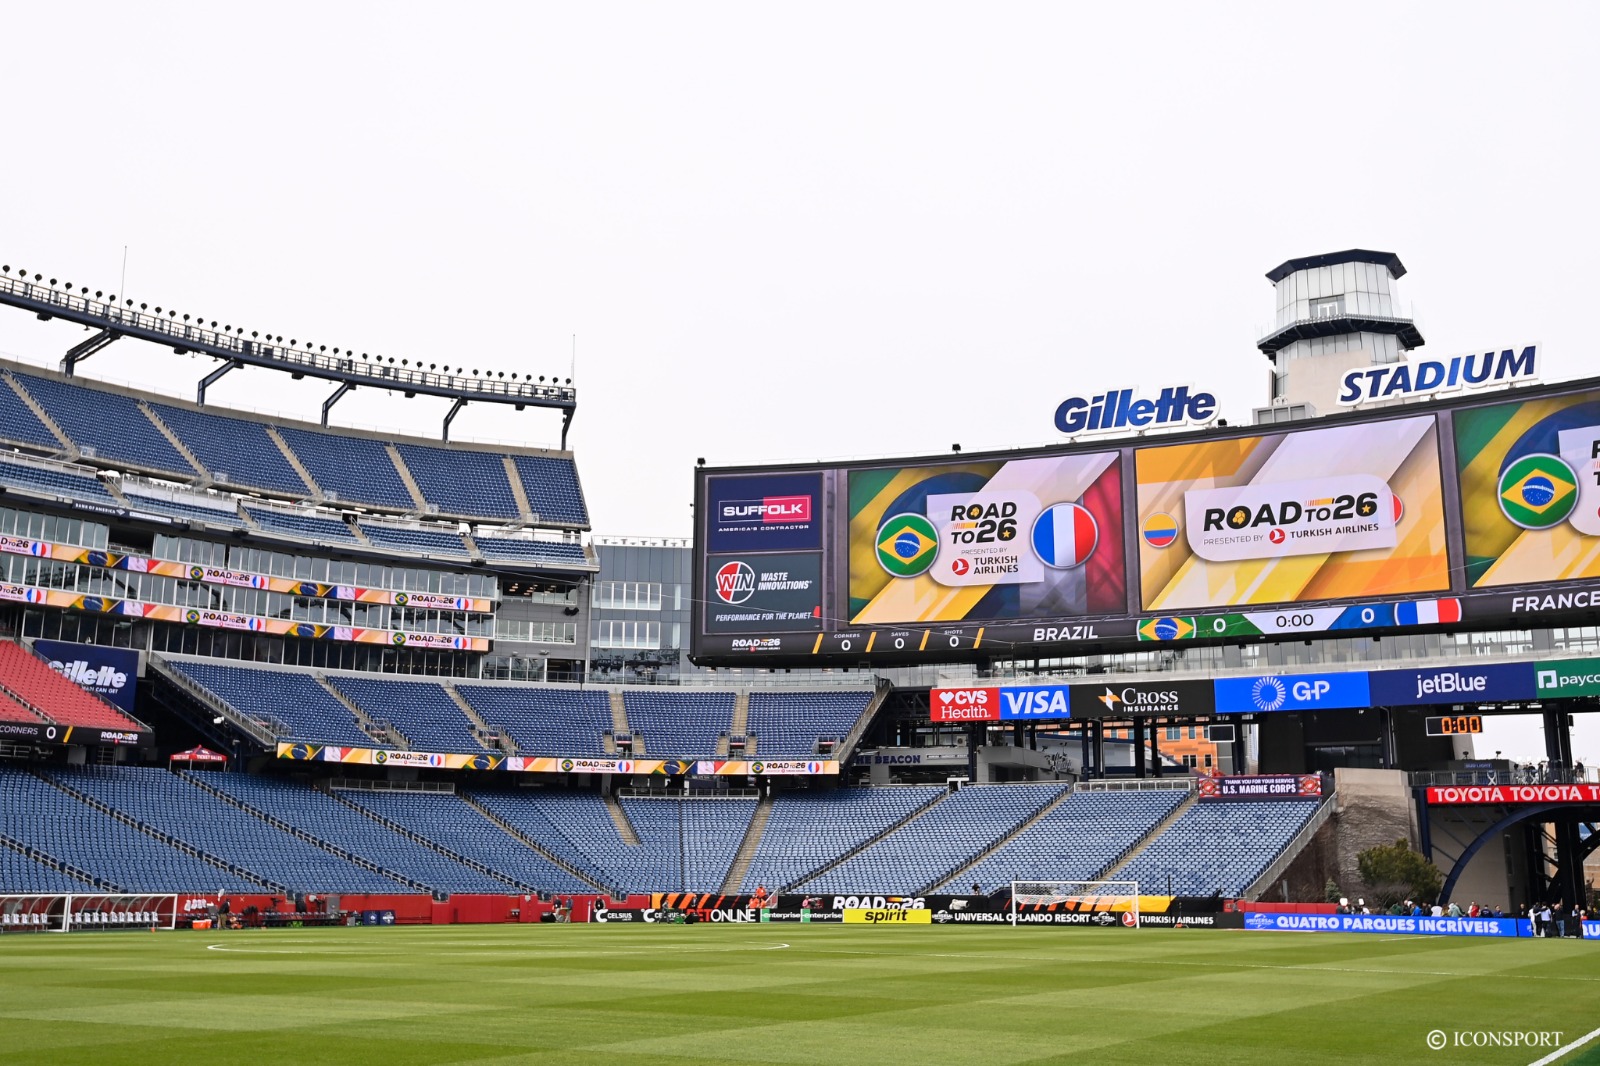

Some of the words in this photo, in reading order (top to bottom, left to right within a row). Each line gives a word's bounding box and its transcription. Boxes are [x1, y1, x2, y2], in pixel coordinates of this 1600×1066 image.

[1340, 345, 1537, 402] STADIUM
[1054, 386, 1216, 433] Gillette
[723, 504, 803, 516] SUFFOLK
[951, 501, 1017, 521] ROAD
[1203, 500, 1303, 531] ROAD
[1305, 506, 1331, 523] TO
[951, 532, 975, 544] TO
[1204, 536, 1251, 546] PRESENTED
[1252, 534, 1264, 542] BY
[1290, 528, 1332, 539] TURKISH
[1335, 522, 1379, 534] AIRLINES
[961, 548, 996, 556] PRESENTED
[974, 555, 1018, 565] TURKISH
[206, 569, 232, 579] ROAD
[974, 564, 1019, 575] AIRLINES
[761, 572, 788, 581] WASTE
[758, 580, 809, 591] INNOVATIONS
[411, 594, 436, 602] ROAD
[1512, 591, 1600, 613] FRANCE
[202, 612, 228, 622] ROAD
[716, 613, 760, 622] PERFORMANCE
[762, 613, 774, 621] FOR
[776, 612, 787, 620] THE
[788, 612, 812, 620] PLANET
[1275, 614, 1314, 628] 0:00
[1361, 608, 1375, 624] 0
[1213, 618, 1226, 634] 0
[408, 634, 434, 642] ROAD
[1033, 626, 1099, 642] BRAZIL
[732, 639, 760, 647] ROAD
[768, 638, 780, 646] 26
[841, 639, 852, 651] 0
[894, 638, 905, 649] 0
[949, 636, 960, 648] 0
[1416, 672, 1485, 699] jetBlue
[954, 690, 988, 704] CVS
[1001, 690, 1068, 715] VISA
[941, 706, 991, 719] Health
[1123, 704, 1179, 712] INSURANCE
[1442, 716, 1480, 734] 0:00
[0, 725, 38, 735] CORNERS
[46, 726, 56, 740] 0
[390, 752, 412, 760] ROAD
[874, 755, 921, 764] BEACON
[1222, 786, 1238, 794] U.S.
[1240, 784, 1268, 794] MARINE
[1270, 784, 1296, 793] CORPS
[1434, 787, 1504, 802] TOYOTA
[1510, 786, 1583, 801] TOYOTA
[832, 896, 886, 910] ROAD
[763, 911, 801, 919] enterprise
[804, 911, 843, 919] enterprise
[864, 910, 908, 924] spirit
[954, 912, 1004, 922] UNIVERSAL
[1054, 914, 1090, 922] RESORT
[1140, 916, 1175, 924] TURKISH
[1176, 916, 1214, 924] AIRLINES
[1276, 916, 1340, 930] QUATRO
[1344, 918, 1416, 931] PARQUES
[1418, 917, 1502, 934] INCRÍVEIS.
